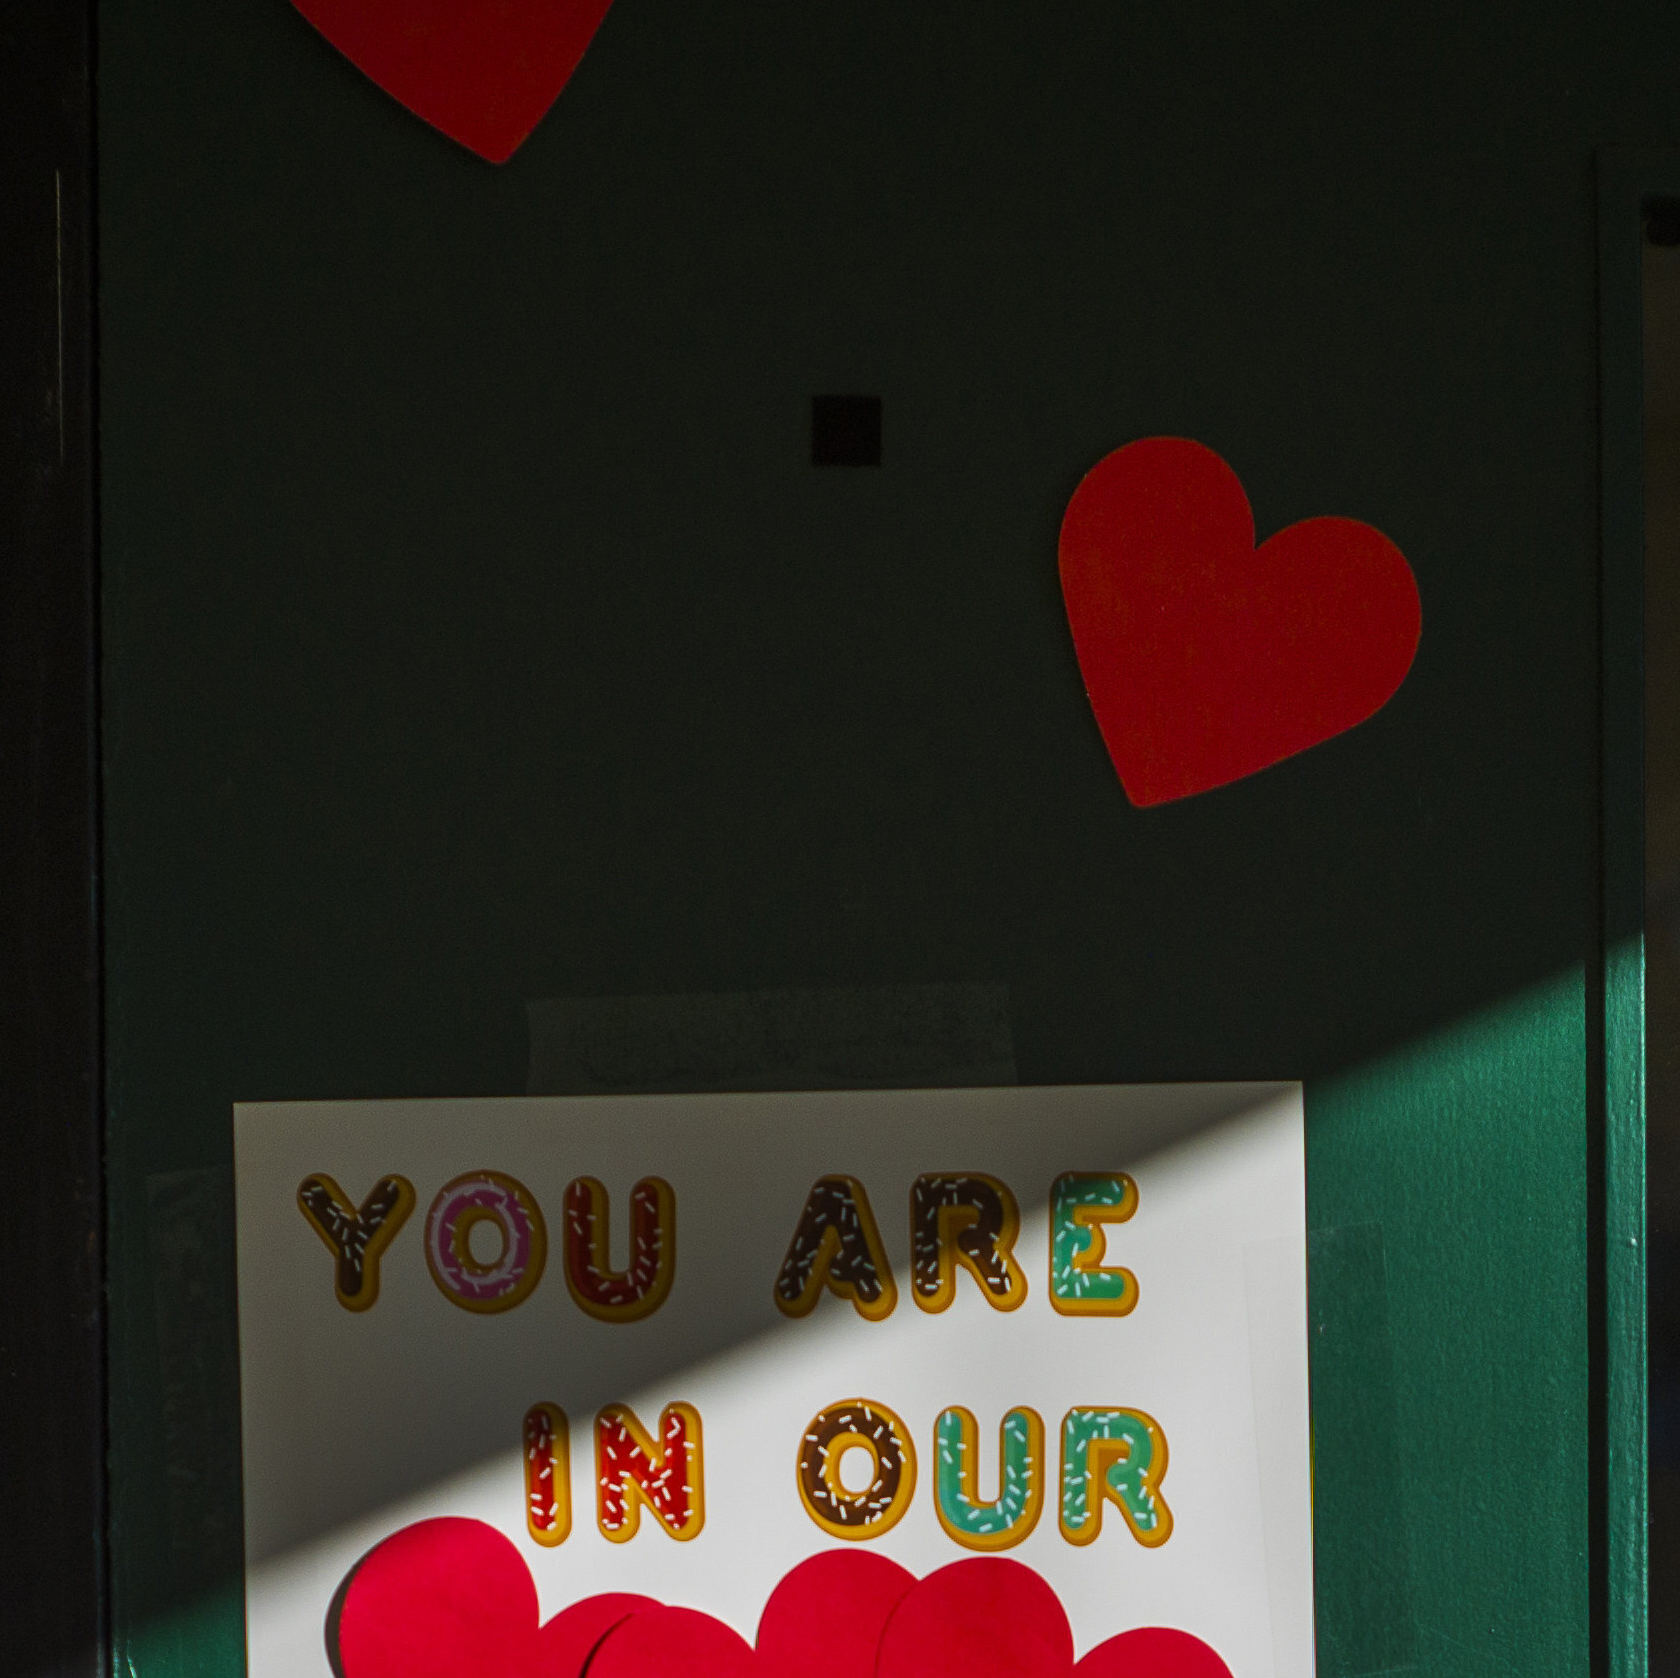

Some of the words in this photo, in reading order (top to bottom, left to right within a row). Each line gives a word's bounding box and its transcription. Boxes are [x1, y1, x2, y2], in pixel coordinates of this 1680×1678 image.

[296, 1170, 676, 1323] YOU
[773, 1170, 1139, 1322] ARE
[521, 1400, 706, 1547] IN
[796, 1396, 1174, 1551] OUR
